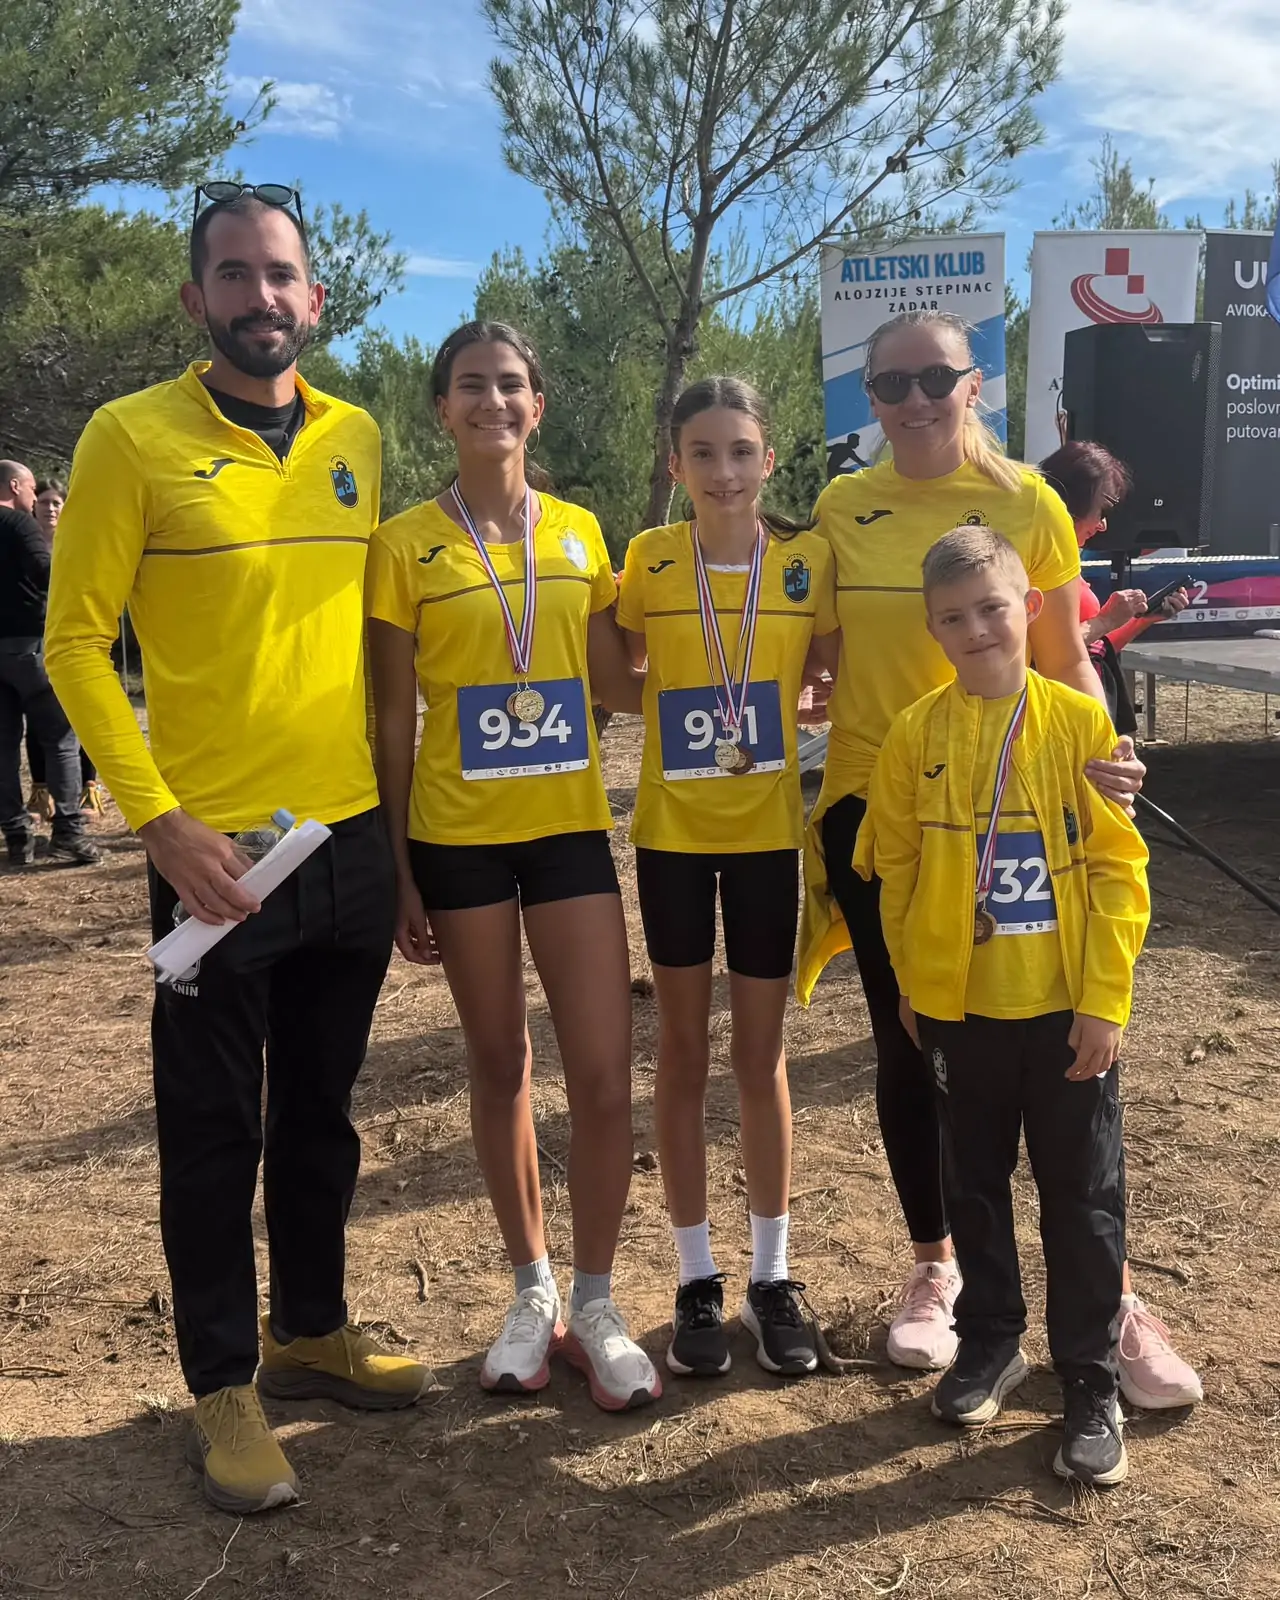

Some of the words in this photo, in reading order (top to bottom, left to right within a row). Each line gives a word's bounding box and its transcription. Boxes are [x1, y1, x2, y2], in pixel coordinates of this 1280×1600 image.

[841, 254, 930, 283] ATLETSKI
[934, 251, 986, 278] KLUB
[834, 287, 907, 301] ALOJZIJE
[915, 282, 993, 296] STEPINAC
[889, 300, 939, 313] ZADAR
[479, 704, 572, 750] 934
[684, 705, 758, 751] 931
[991, 857, 1051, 904] 32
